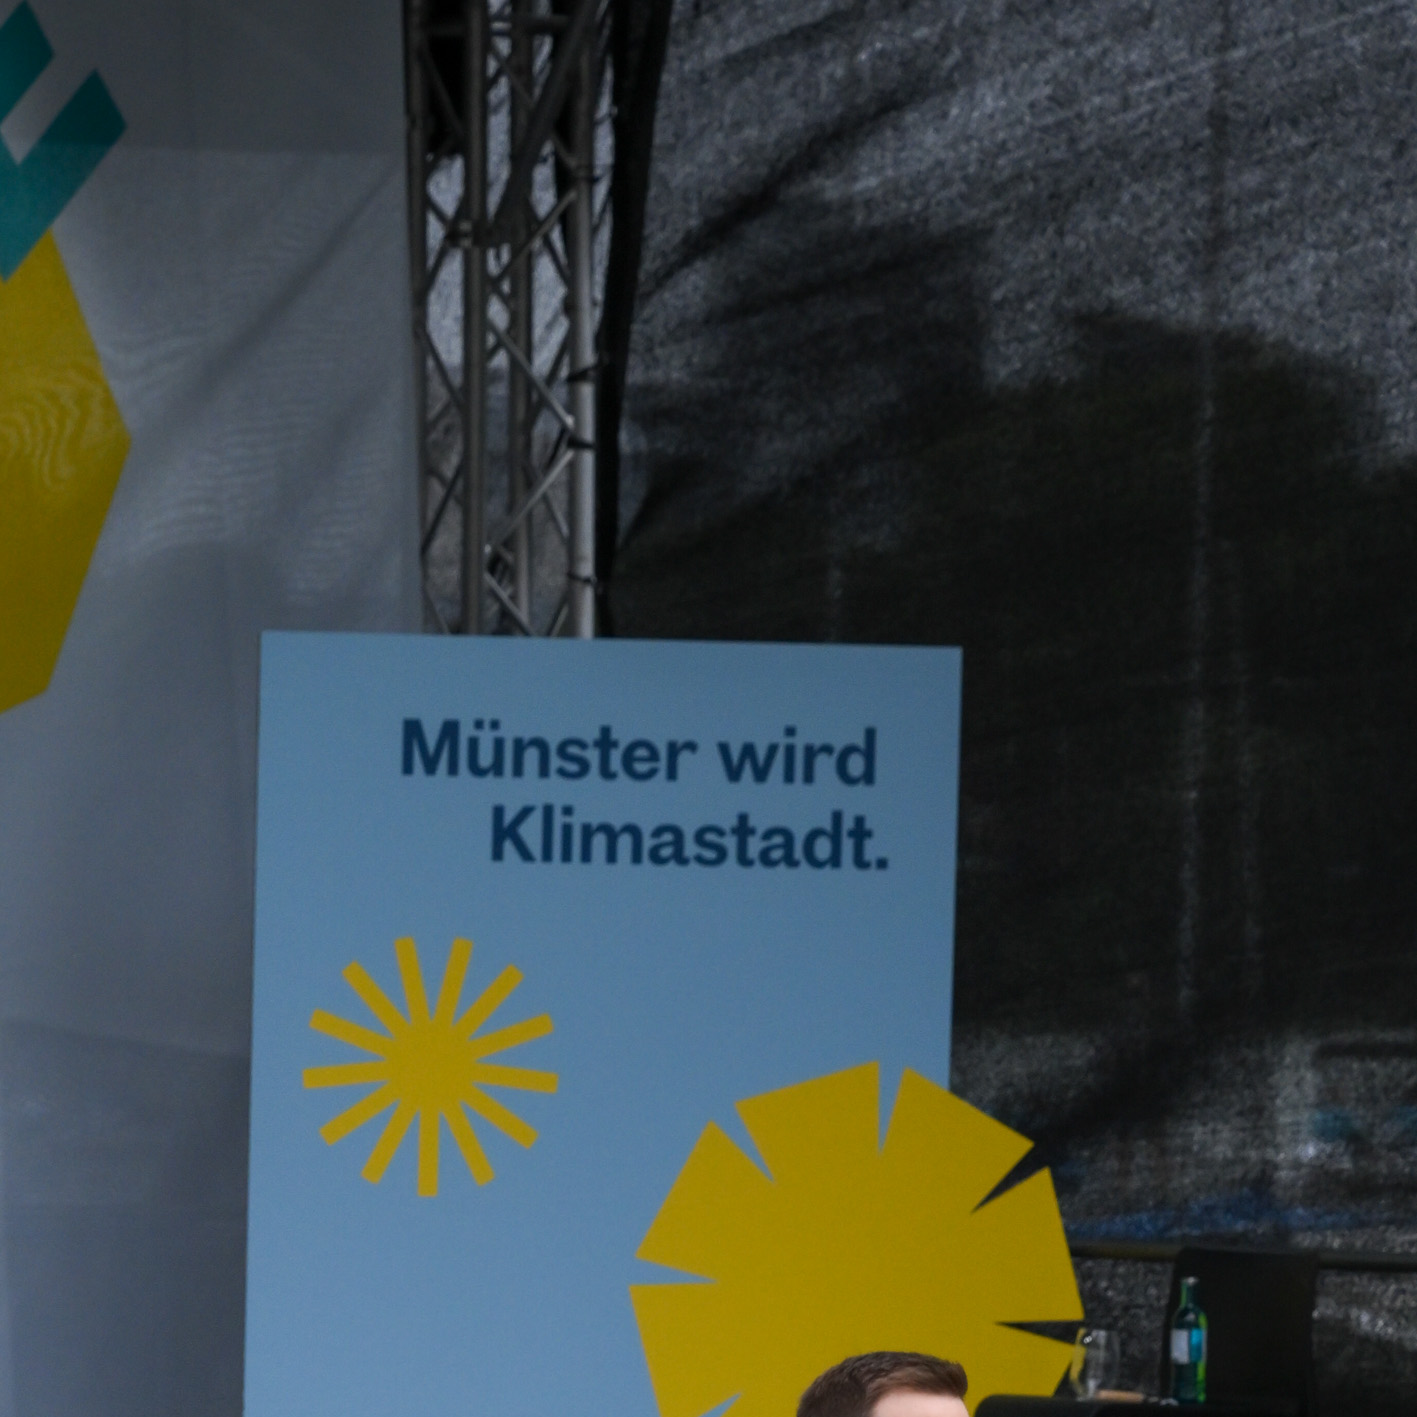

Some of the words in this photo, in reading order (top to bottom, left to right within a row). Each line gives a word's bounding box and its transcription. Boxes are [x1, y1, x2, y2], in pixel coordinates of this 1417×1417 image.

[400, 717, 698, 783] Münster
[718, 727, 878, 787] wird
[490, 803, 890, 872] Klimastadt.
